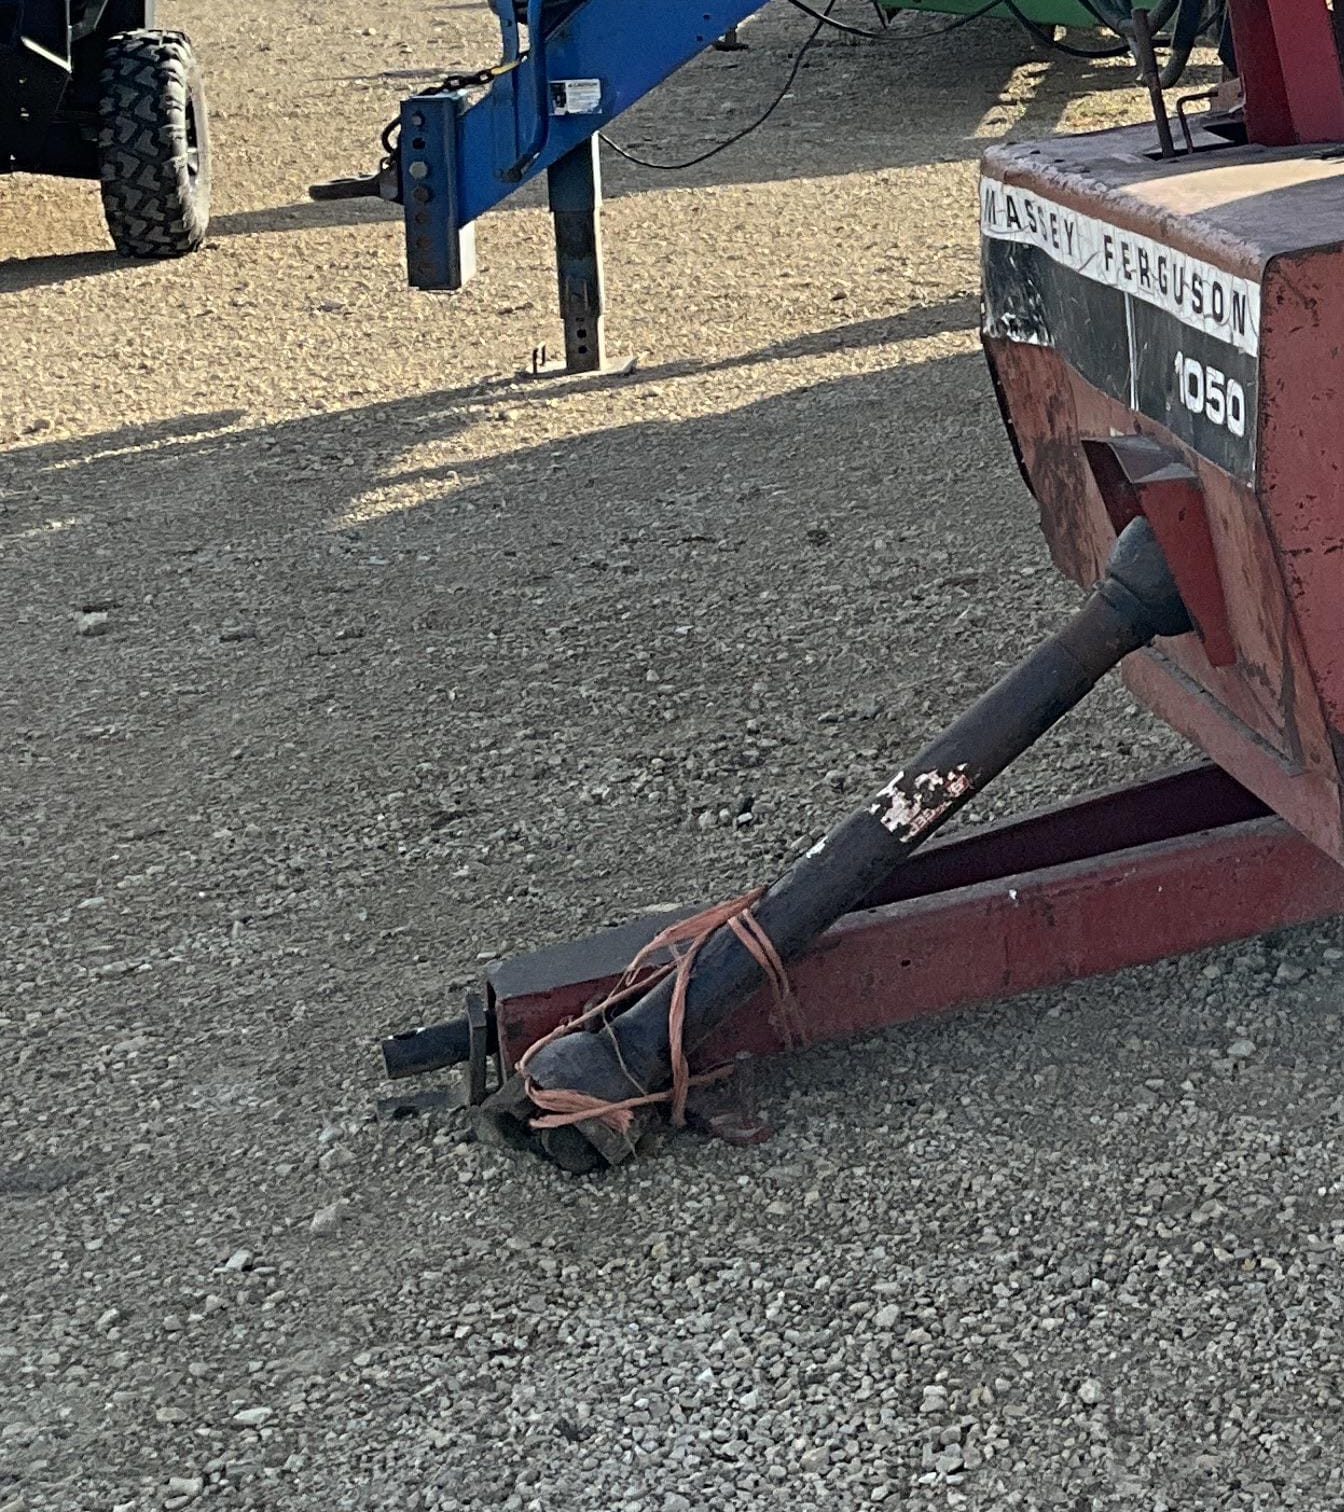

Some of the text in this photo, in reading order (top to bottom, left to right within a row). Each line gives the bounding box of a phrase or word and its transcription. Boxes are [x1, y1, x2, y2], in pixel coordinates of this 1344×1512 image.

[984, 188, 1246, 336] MASSEY FERGUSON
[1174, 349, 1246, 438] 1050
